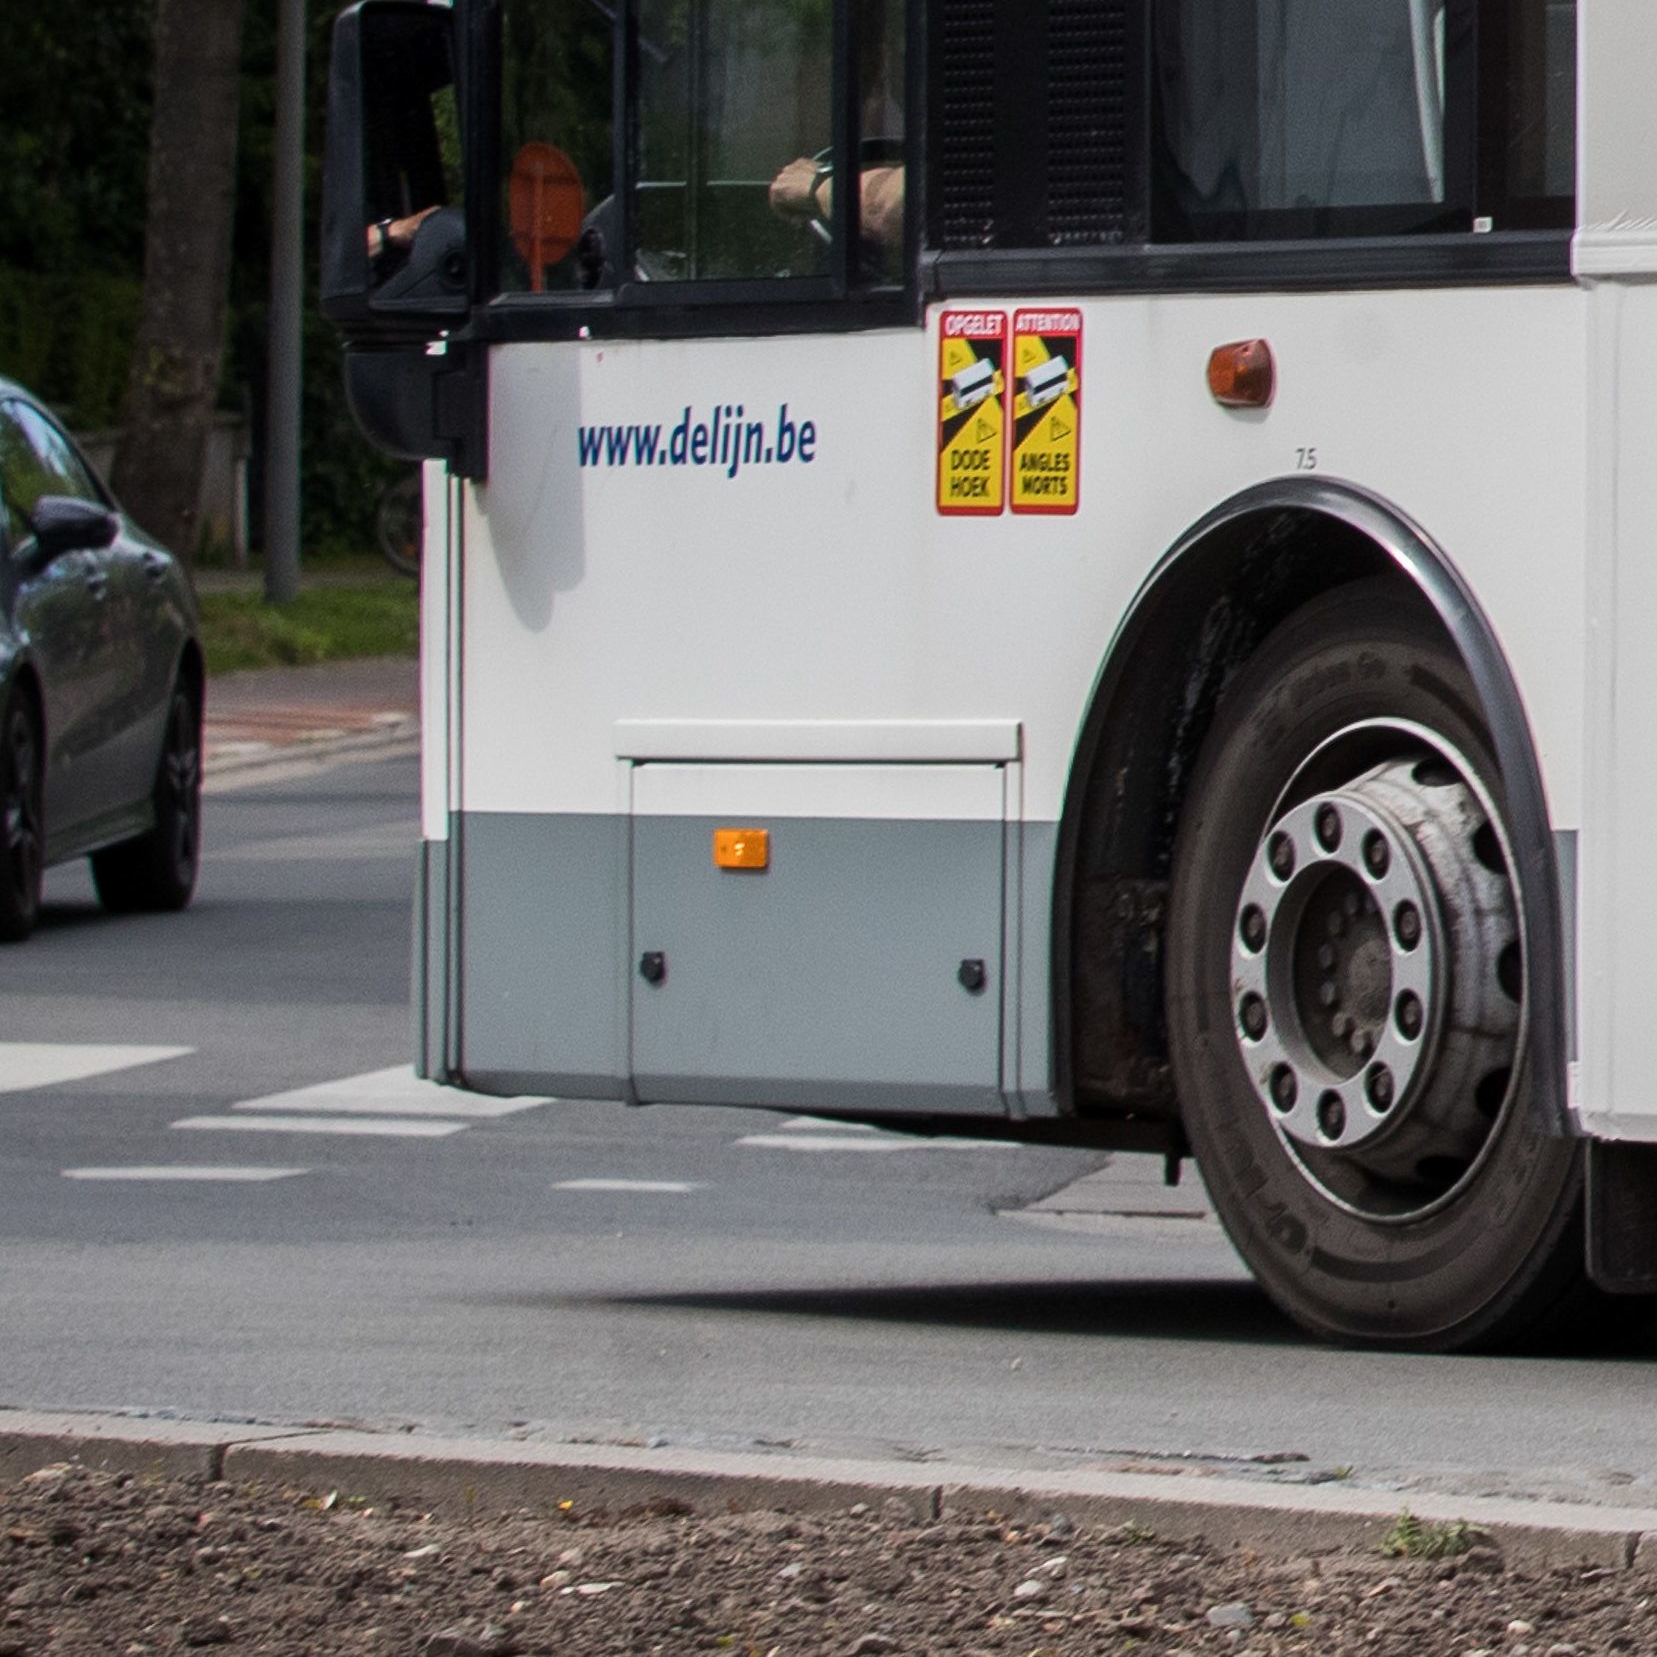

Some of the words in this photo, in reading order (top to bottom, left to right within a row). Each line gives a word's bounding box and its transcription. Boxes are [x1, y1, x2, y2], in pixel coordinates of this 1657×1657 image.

[944, 314, 1004, 336] OPGELET
[1015, 312, 1081, 332] ATTENTION
[578, 402, 817, 479] www.delijn.be
[950, 449, 991, 471] DODE
[1019, 452, 1071, 472] ANGLES
[949, 476, 991, 498] HOEK
[1021, 475, 1068, 496] MORTS
